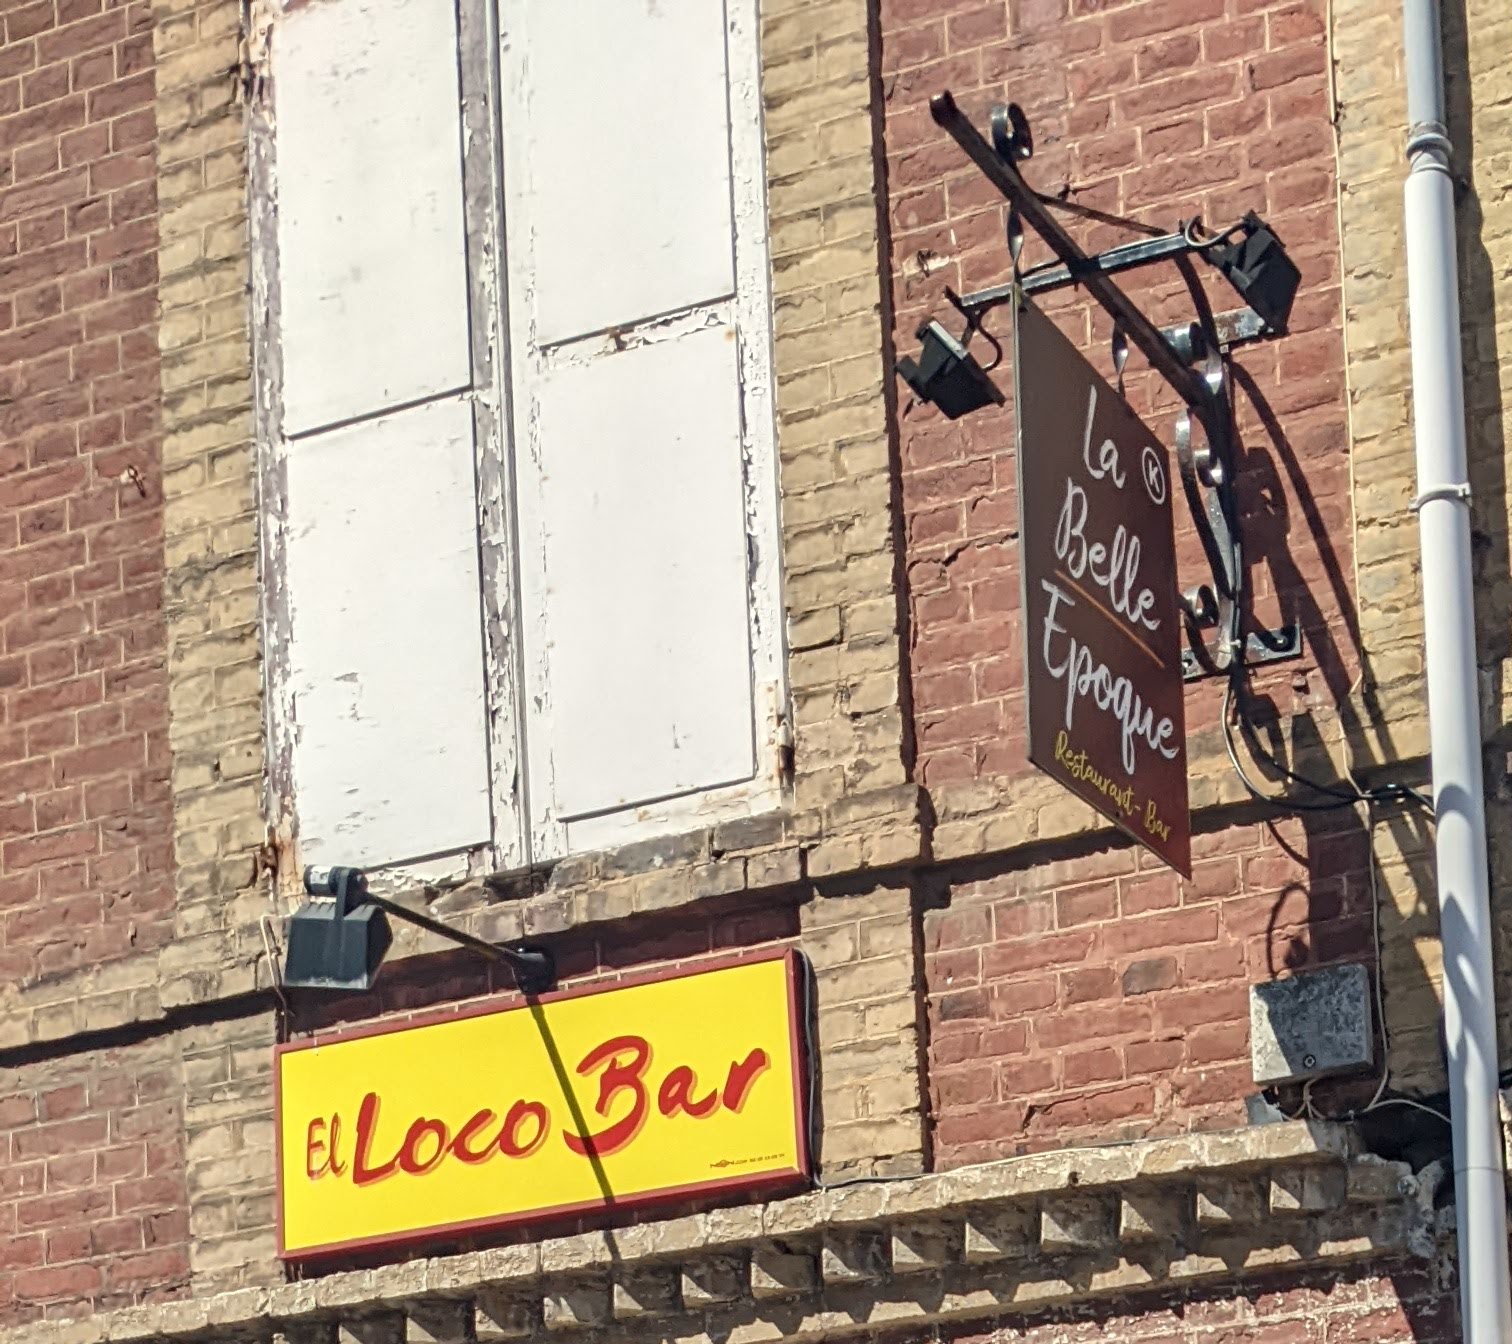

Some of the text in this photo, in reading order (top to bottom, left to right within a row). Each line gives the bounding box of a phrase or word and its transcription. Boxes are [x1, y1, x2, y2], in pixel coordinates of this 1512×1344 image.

[1083, 385, 1126, 489] La
[1055, 478, 1160, 631] Belle
[1042, 580, 1179, 775] Epoque
[1145, 800, 1171, 842] Bar
[307, 1035, 771, 1187] El Loco Bar
